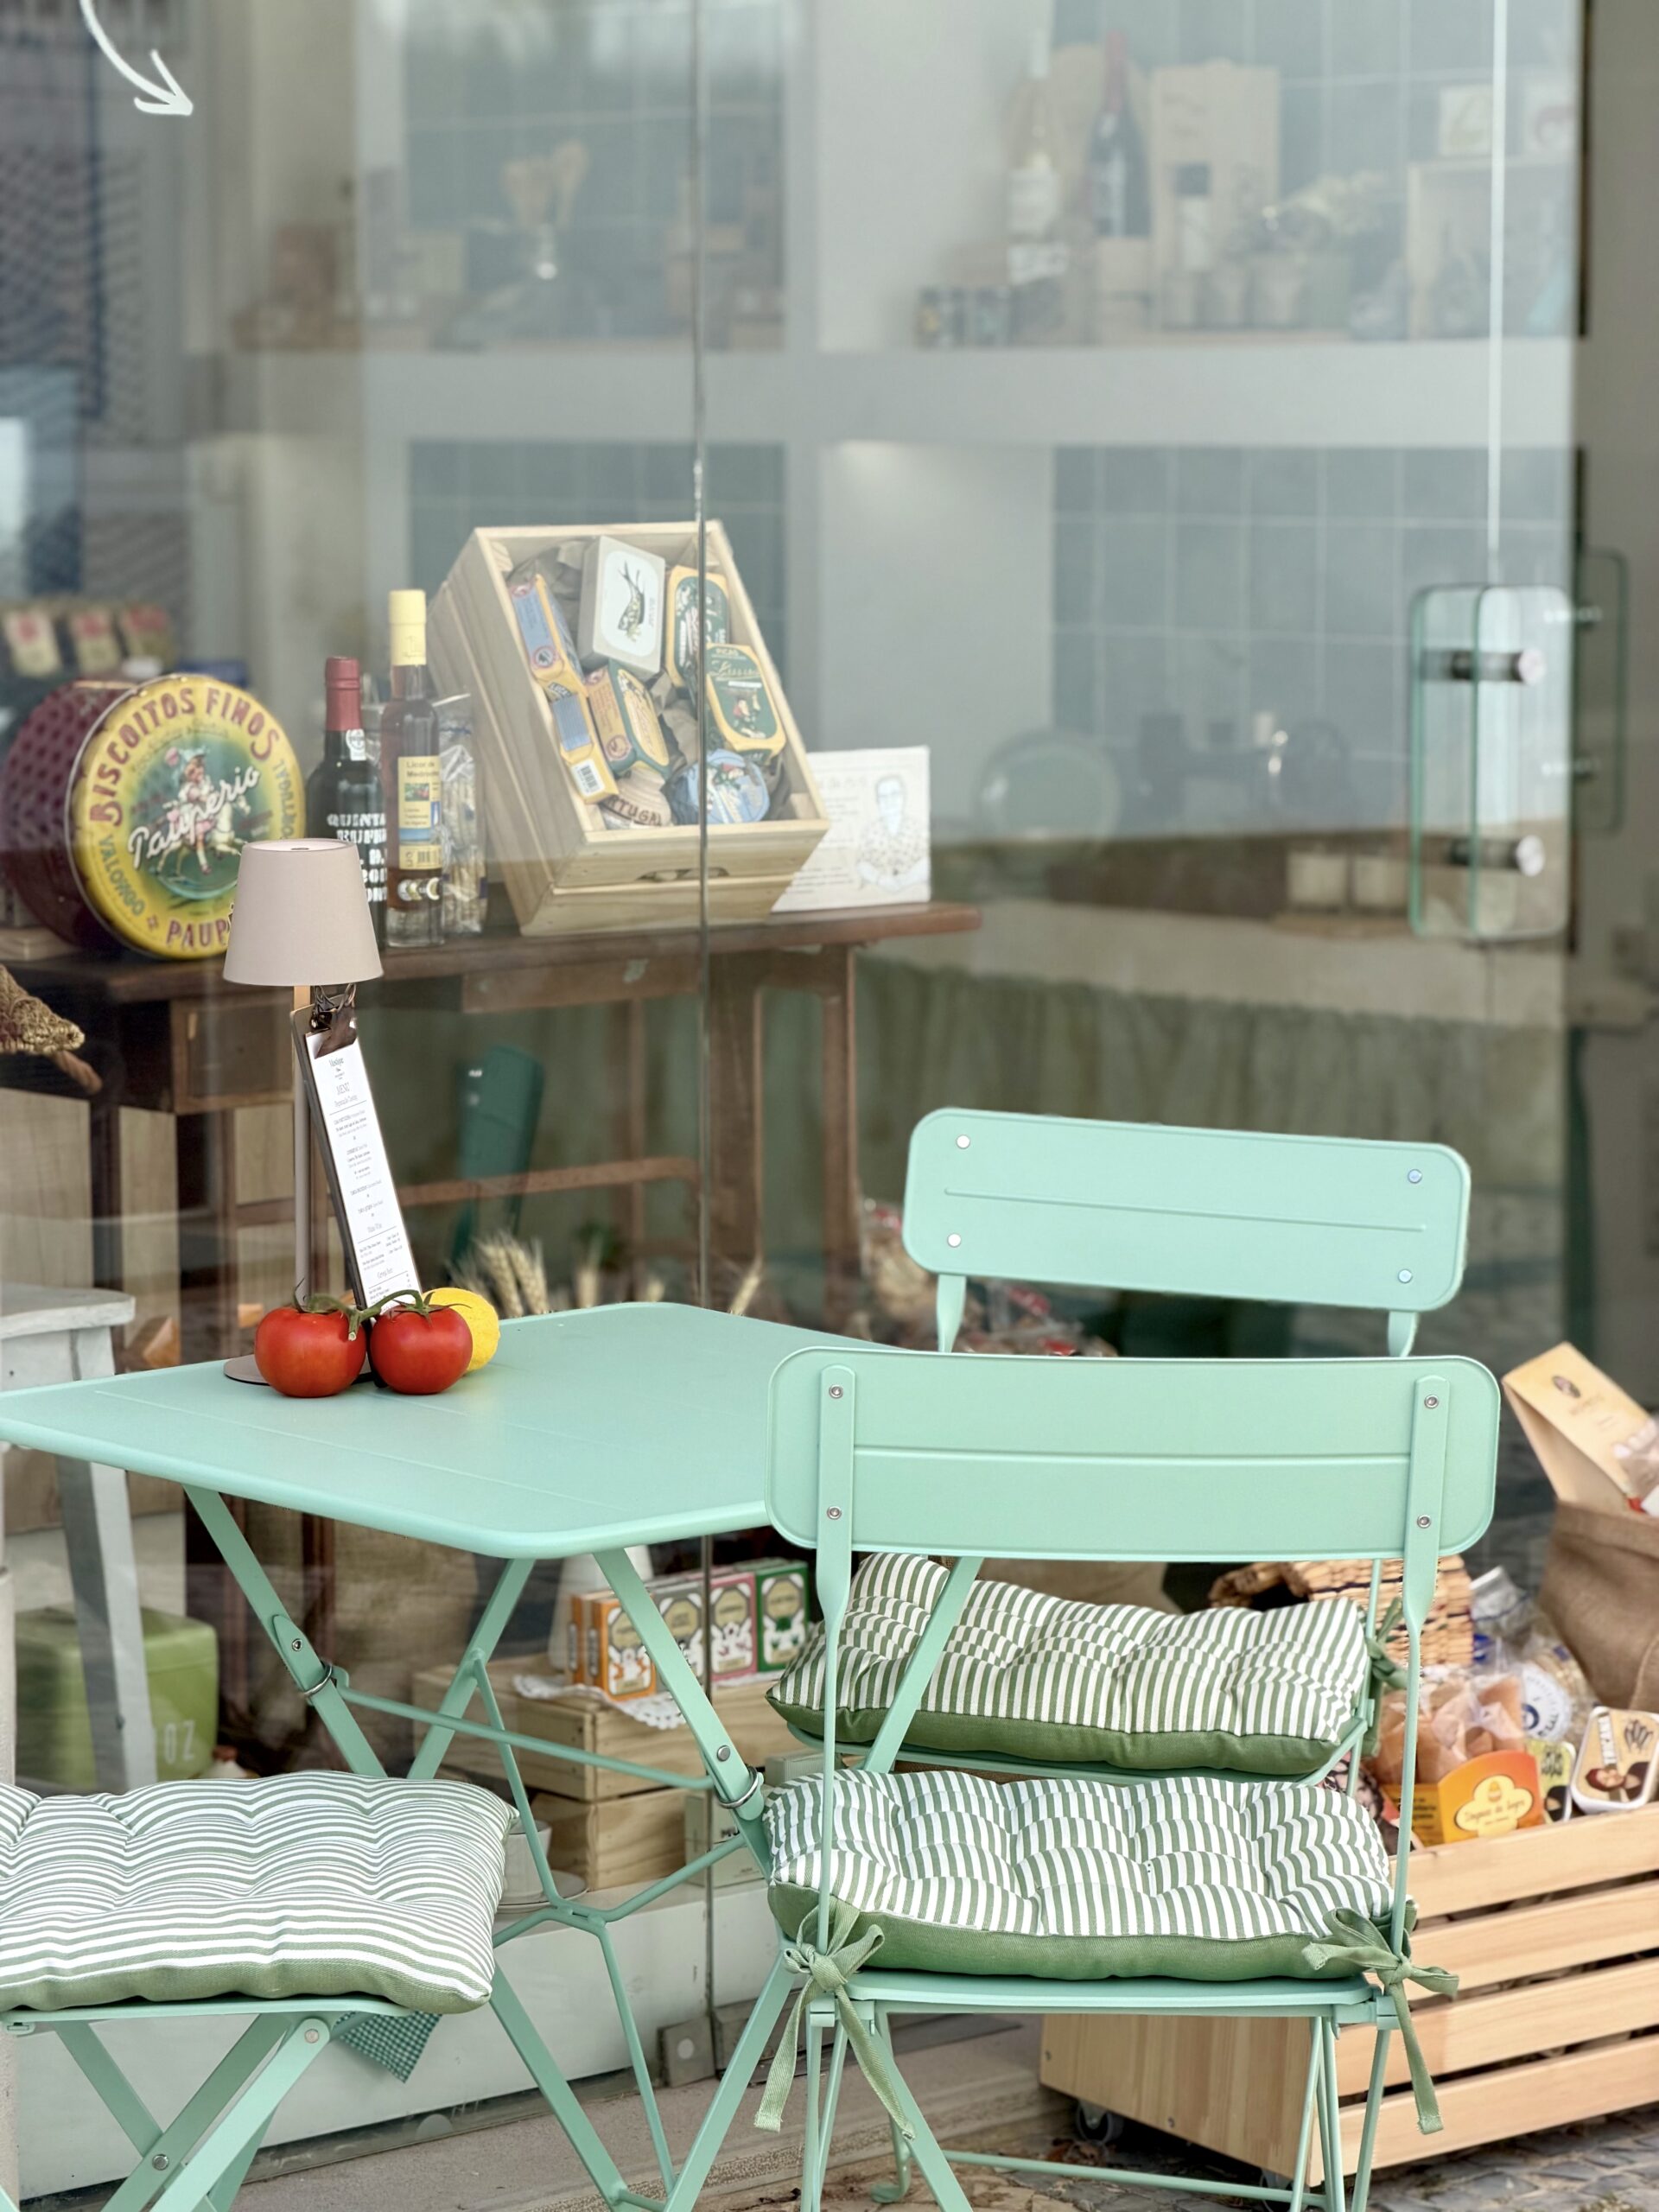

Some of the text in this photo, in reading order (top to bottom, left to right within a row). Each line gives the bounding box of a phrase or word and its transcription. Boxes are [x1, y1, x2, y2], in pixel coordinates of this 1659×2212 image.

[89, 687, 195, 828] BISCOITOS
[205, 687, 280, 761] FINOS
[271, 758, 298, 840] ORTUGAL
[607, 794, 662, 827] RTUGAL
[98, 834, 146, 917] VALONGO
[166, 918, 232, 949] PAUP
